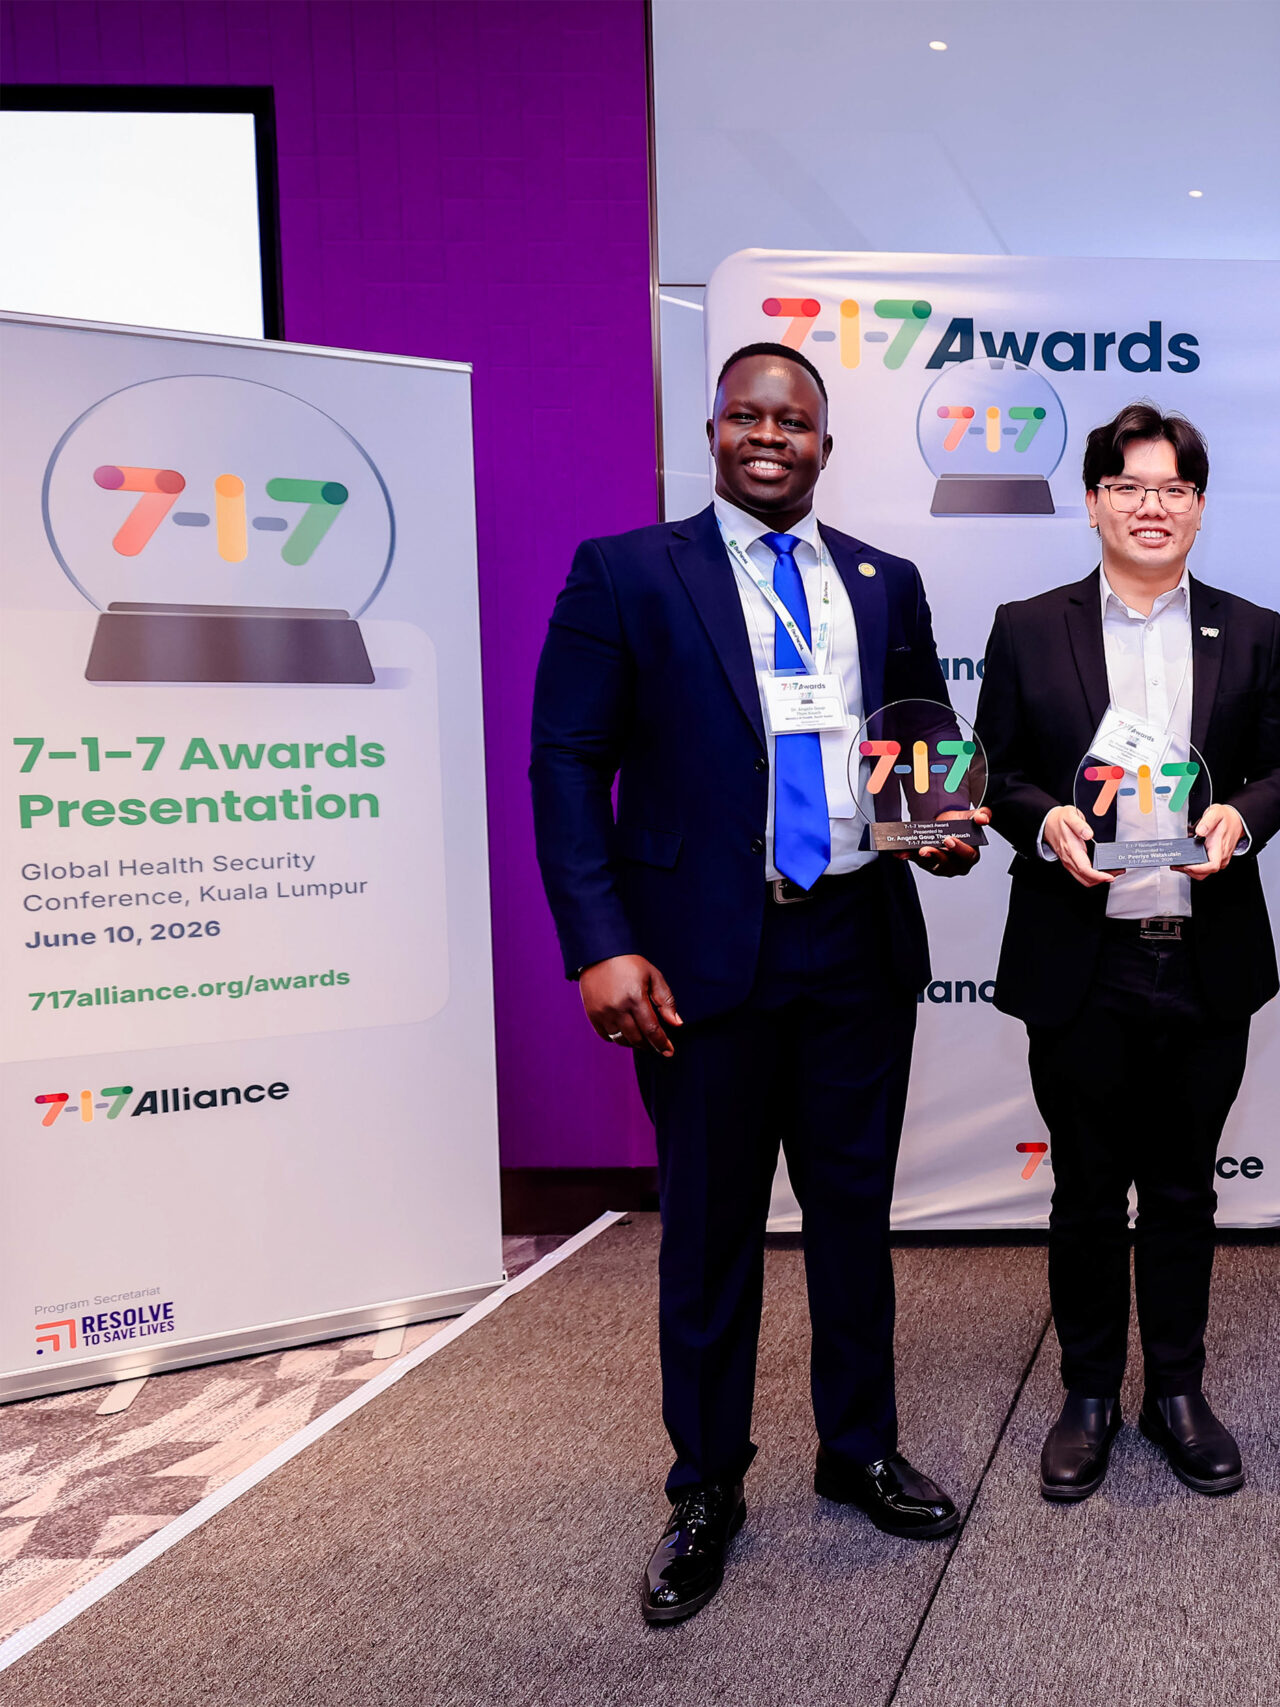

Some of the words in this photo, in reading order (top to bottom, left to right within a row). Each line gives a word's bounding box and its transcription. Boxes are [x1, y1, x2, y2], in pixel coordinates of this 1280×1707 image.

[179, 734, 386, 771] Awards
[18, 783, 380, 829] Presentation
[21, 862, 110, 882] Global
[119, 857, 204, 878] Health
[213, 851, 316, 873] Security
[23, 887, 190, 912] Conference,
[200, 881, 268, 902] Kuala
[276, 878, 368, 901] Lumpur
[25, 929, 96, 949] June
[104, 926, 142, 946] 10,
[150, 919, 222, 942] 2026
[29, 968, 351, 1011] 717alliance.org/awards
[131, 1081, 290, 1118] Alliance
[34, 1300, 90, 1316] Program
[93, 1287, 161, 1305] Secretariat
[81, 1301, 175, 1334] RESOLVE
[83, 1334, 100, 1346] TO
[103, 1327, 137, 1343] SAVE
[139, 1320, 175, 1337] LIVES
